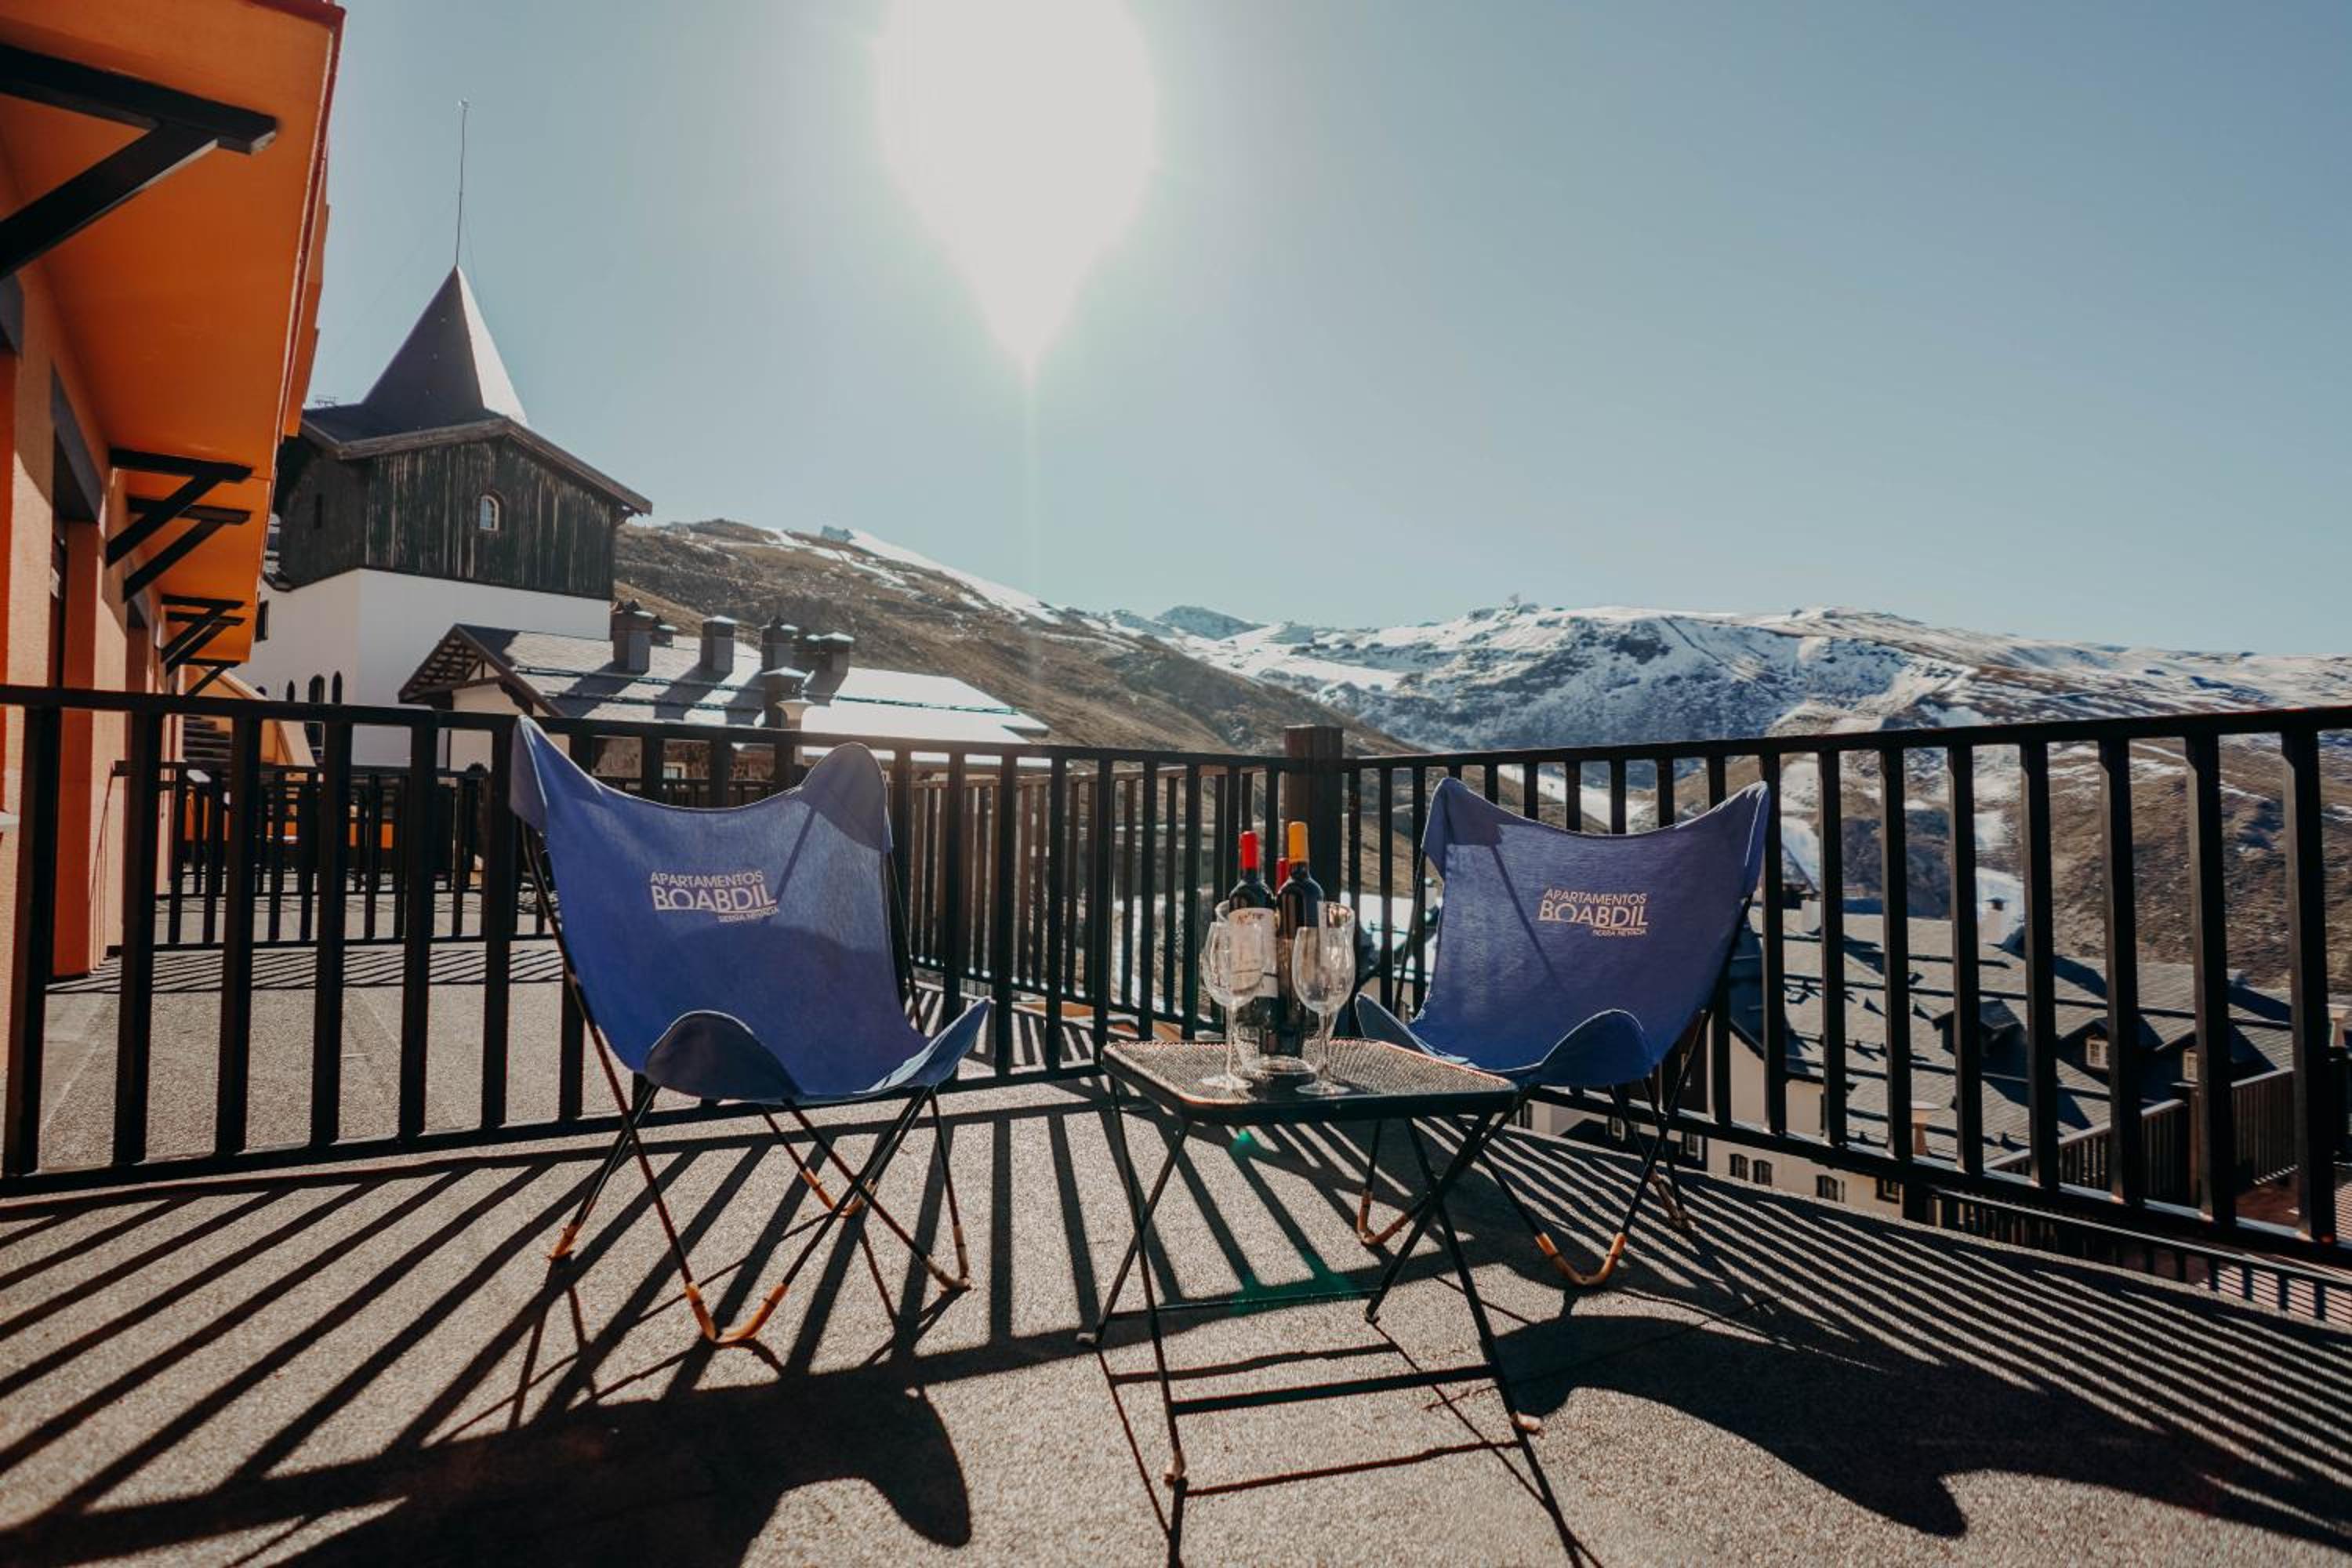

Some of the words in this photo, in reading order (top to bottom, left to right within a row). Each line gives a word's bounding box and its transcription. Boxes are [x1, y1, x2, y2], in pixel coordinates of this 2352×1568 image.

[650, 871, 764, 887] APARTAMENTOS
[651, 884, 778, 911] BOABDIL
[1544, 888, 1647, 905] APARTAMENTOS
[1539, 900, 1649, 927] BOABDIL
